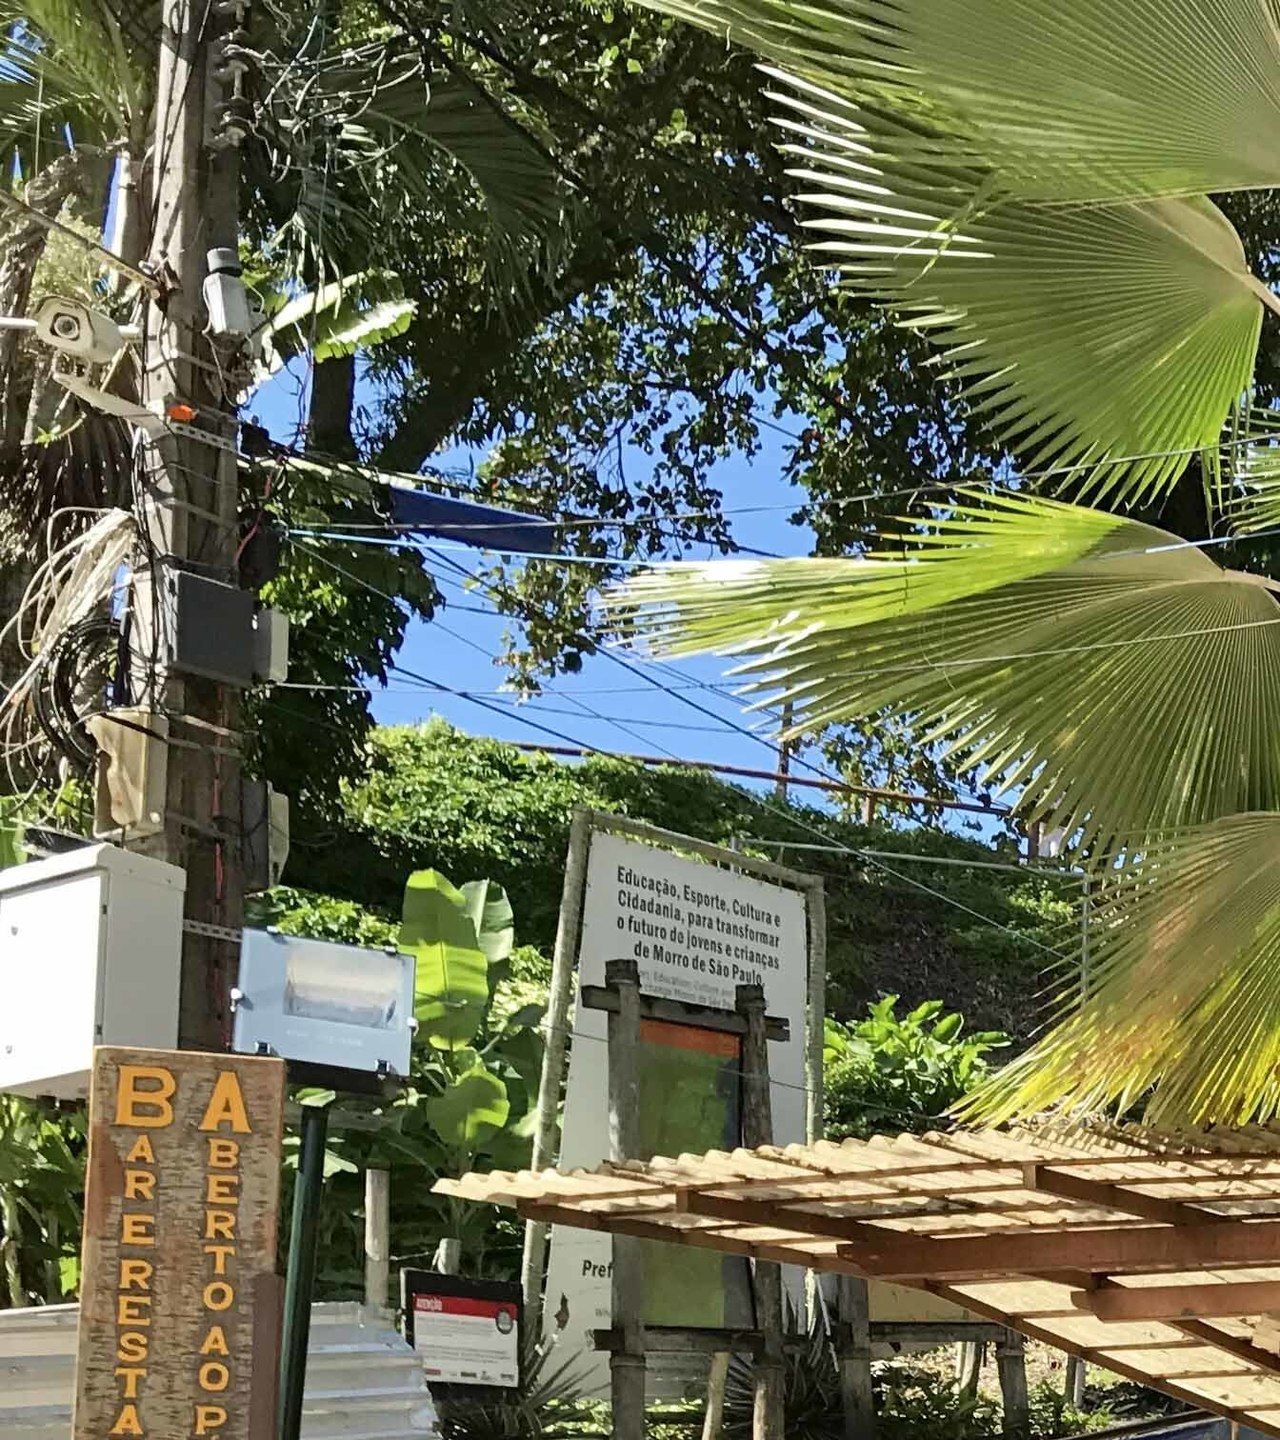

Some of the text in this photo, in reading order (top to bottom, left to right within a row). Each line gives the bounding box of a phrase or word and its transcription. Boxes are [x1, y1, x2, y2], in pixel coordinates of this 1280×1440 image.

[617, 865, 781, 928] Educação, Esporte, Cultura e
[616, 915, 779, 970] o futuro de jovens e crianças
[634, 940, 649, 959] de
[652, 944, 689, 969] Morro
[691, 954, 706, 973] de
[708, 957, 730, 979] São
[687, 911, 713, 930] para
[716, 919, 779, 948] transformar
[114, 1065, 176, 1200] BAR
[198, 1071, 252, 1311] ABERTO
[199, 1325, 231, 1391] AO
